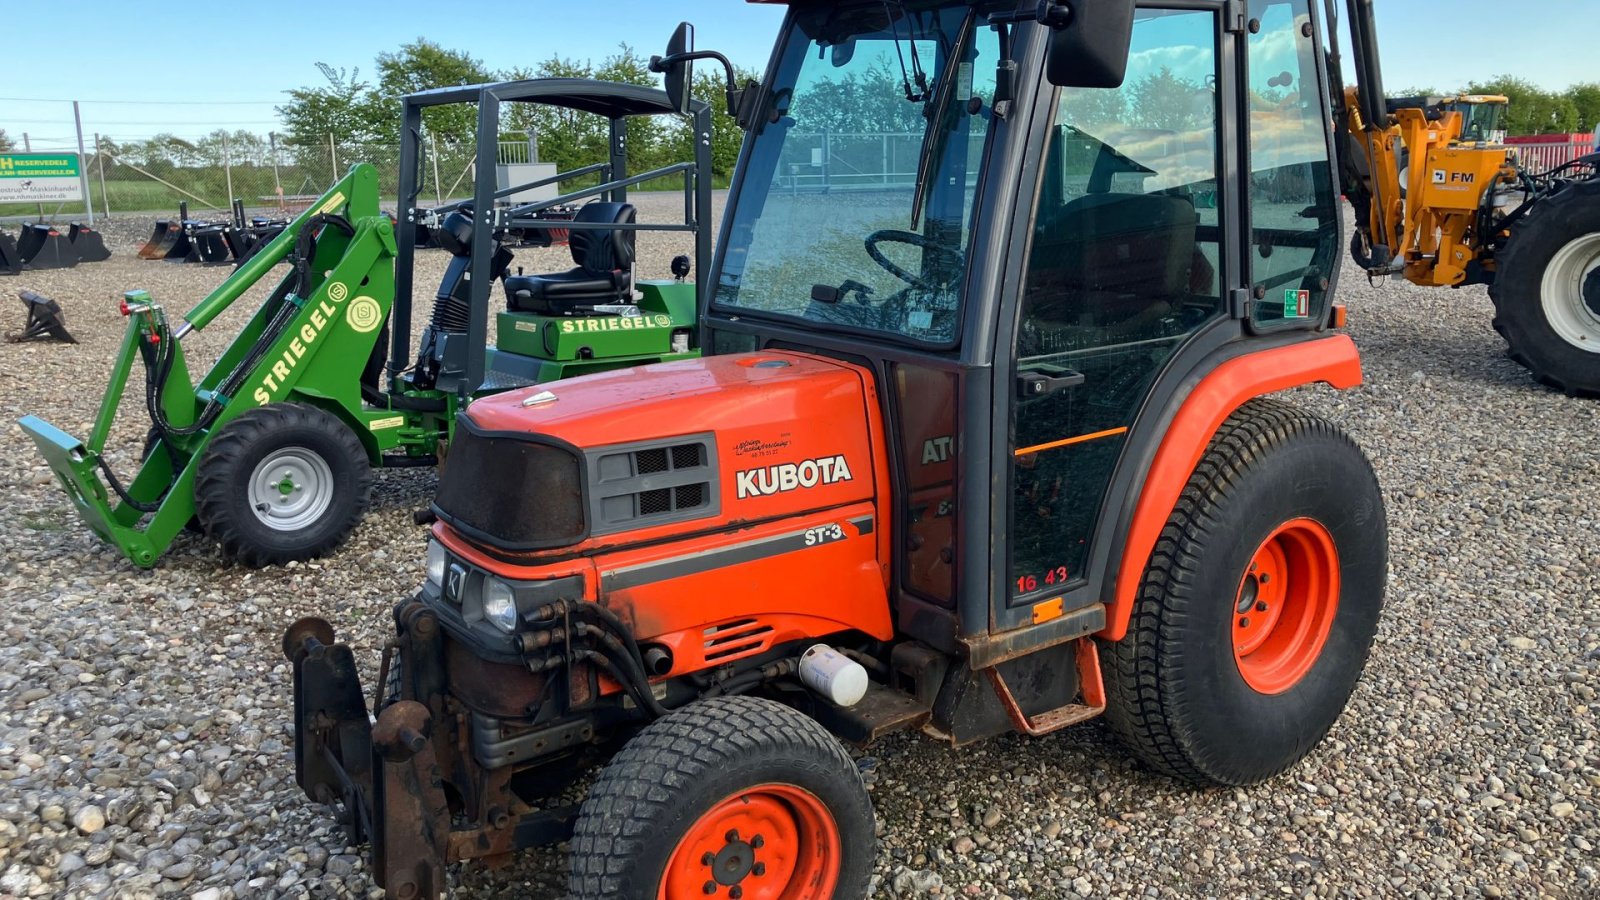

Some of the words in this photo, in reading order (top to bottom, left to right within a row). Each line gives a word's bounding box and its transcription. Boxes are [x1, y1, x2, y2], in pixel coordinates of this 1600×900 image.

[1451, 172, 1474, 183] FM
[562, 315, 656, 333] STRIEGEL
[254, 301, 337, 406] STRIEGEL
[736, 454, 853, 499] KUBOTA
[804, 523, 847, 545] ST-3
[1017, 574, 1038, 593] 16
[1045, 566, 1068, 585] 43
